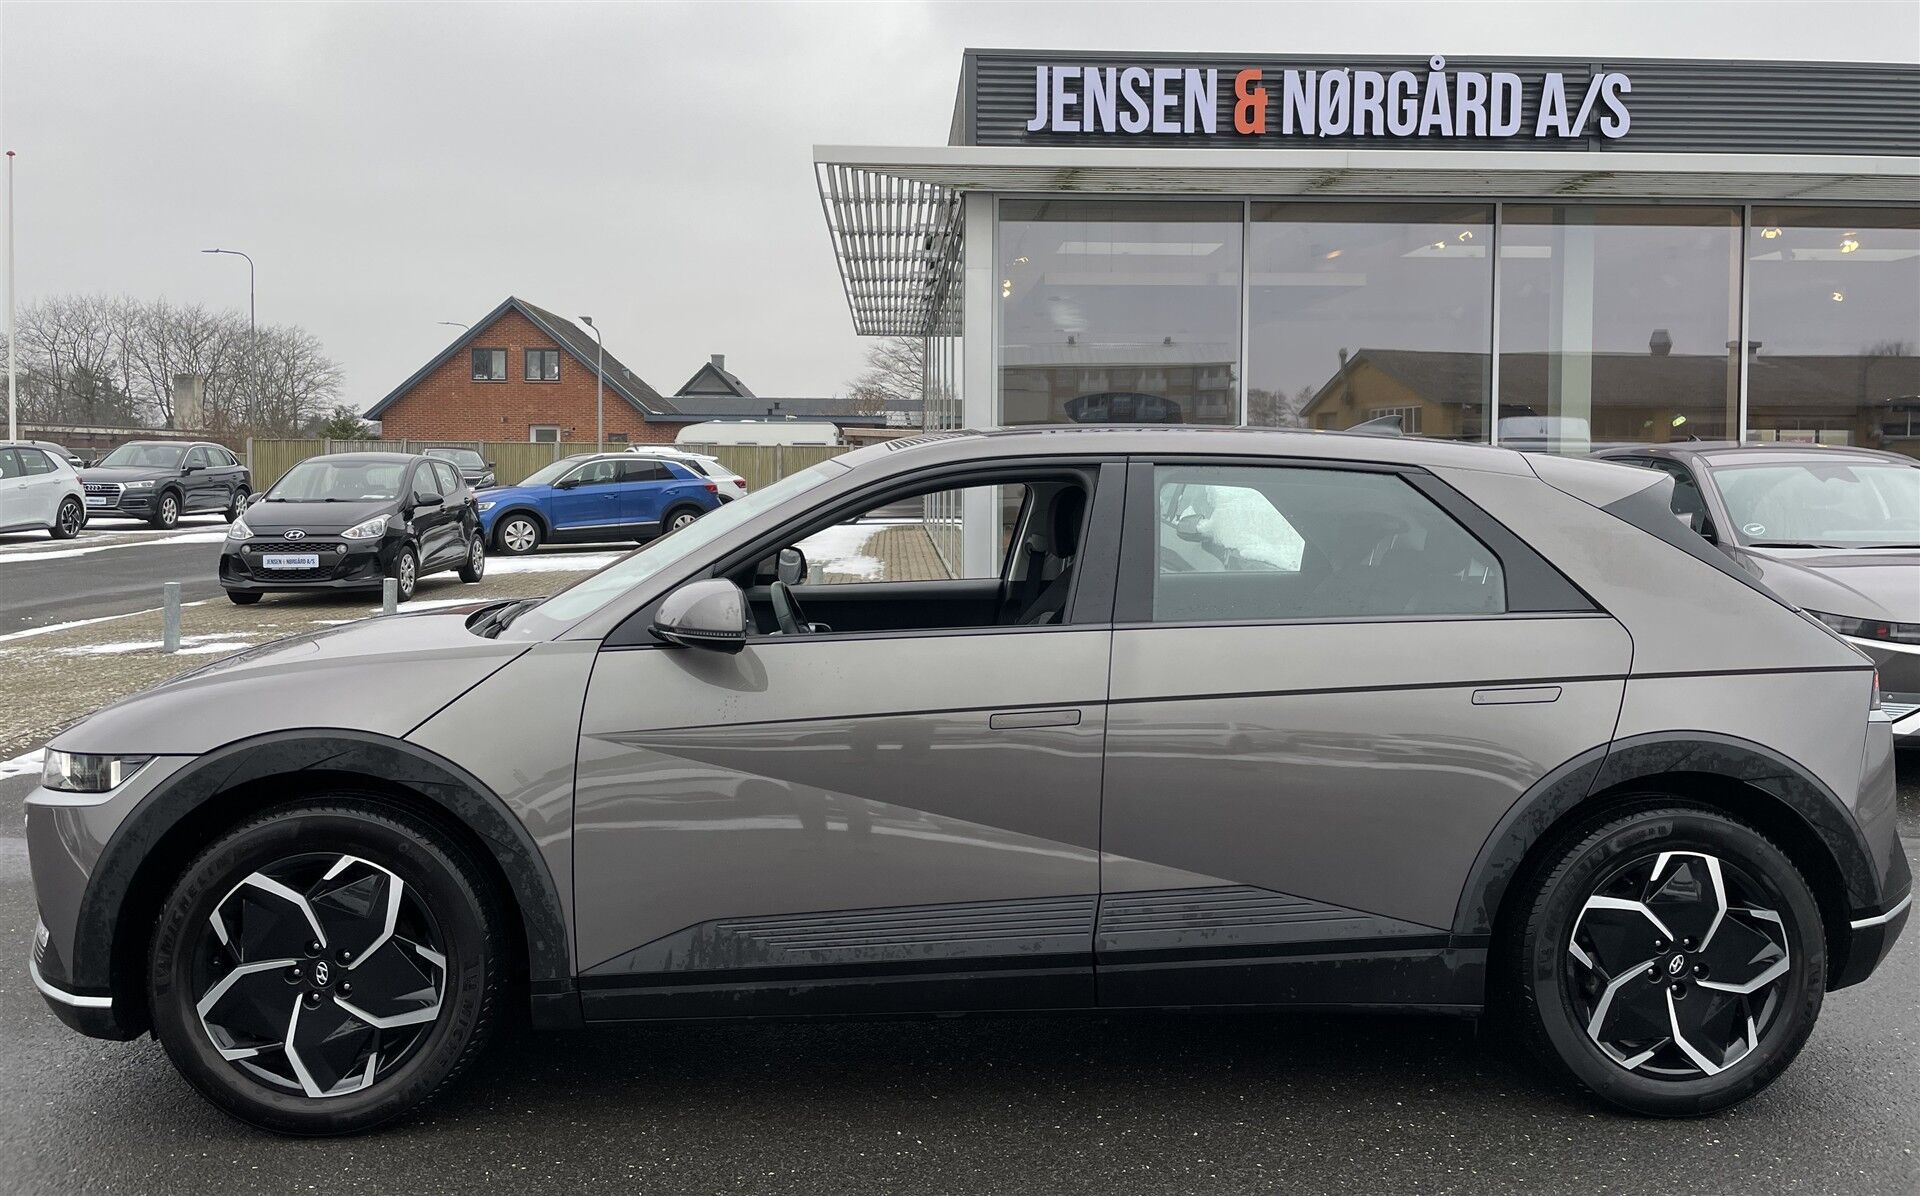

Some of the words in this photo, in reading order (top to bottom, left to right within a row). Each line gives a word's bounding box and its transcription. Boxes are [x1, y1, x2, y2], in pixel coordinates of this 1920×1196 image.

[1028, 66, 1217, 134] JENSEN
[1234, 69, 1268, 134] &
[1283, 54, 1523, 138] NØRGÅRD
[1535, 72, 1631, 138] A/S
